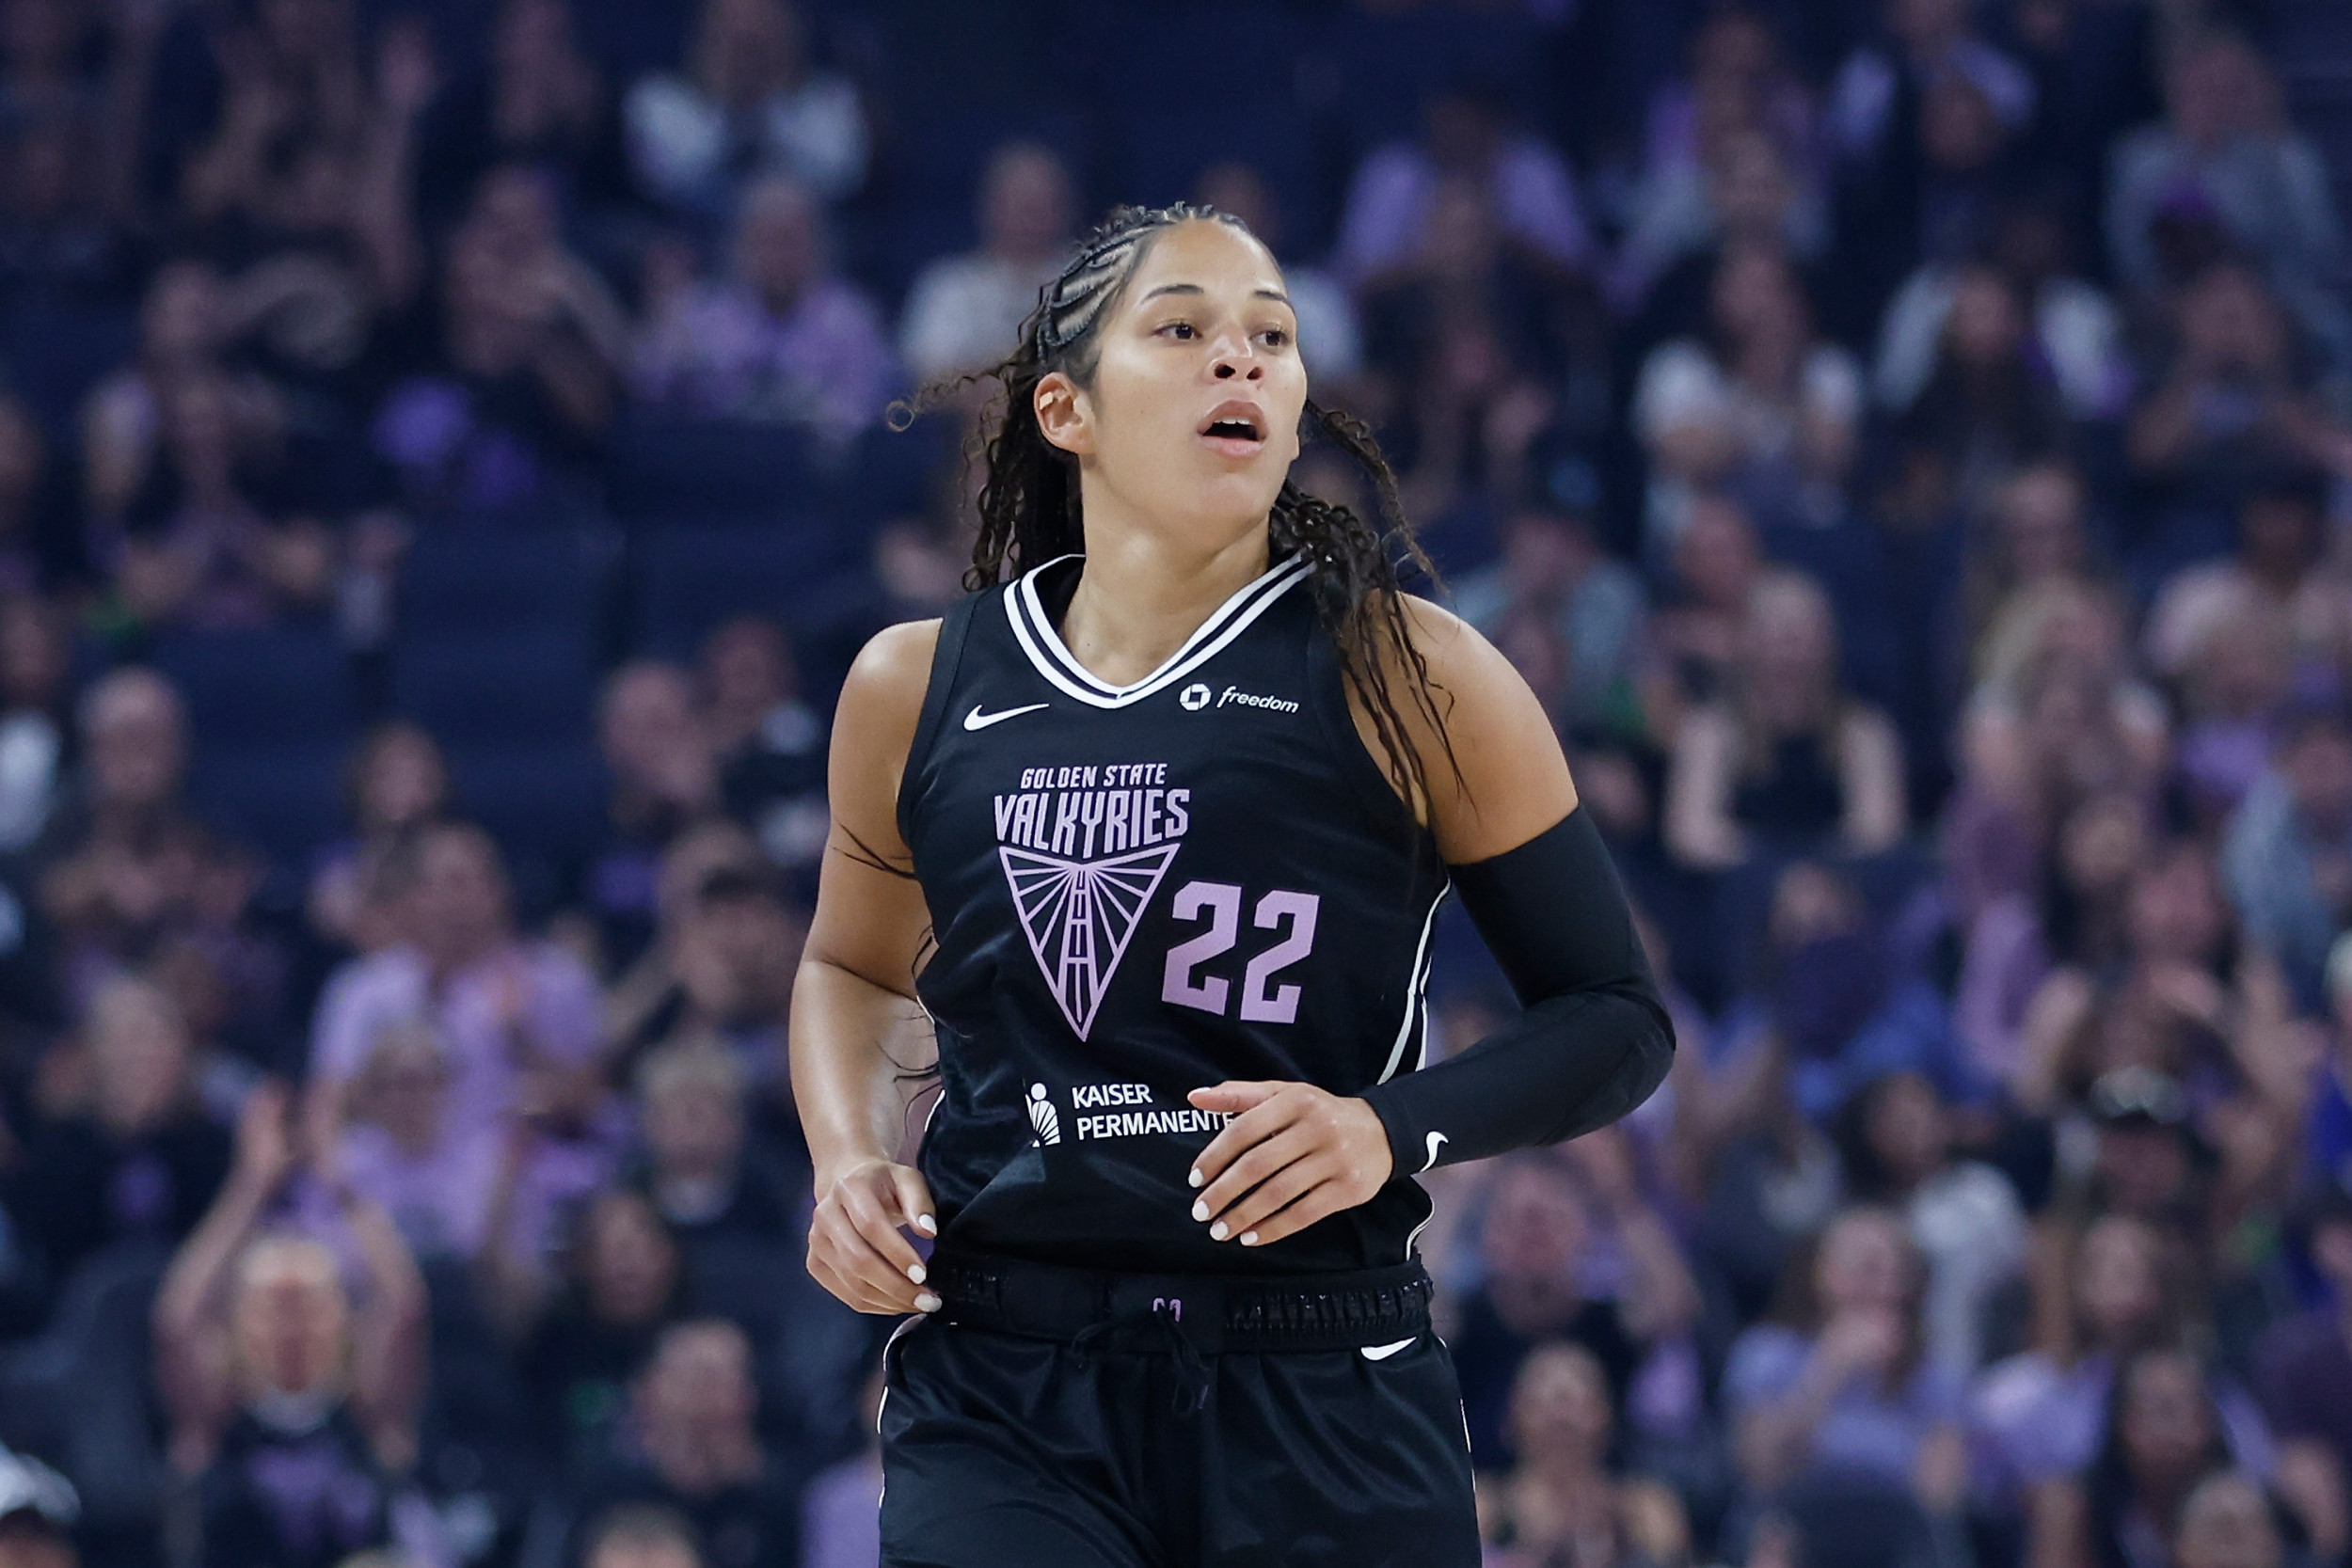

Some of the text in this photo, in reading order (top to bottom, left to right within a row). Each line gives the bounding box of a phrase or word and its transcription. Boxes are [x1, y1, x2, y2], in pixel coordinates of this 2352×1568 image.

[1216, 686, 1299, 714] freedom
[1020, 763, 1168, 789] GOLDEN STATE
[993, 787, 1190, 860] VALKYRIES
[1161, 880, 1320, 1024] 22
[1072, 1084, 1152, 1109] KAISER
[1076, 1109, 1234, 1141] PERMANENTE
